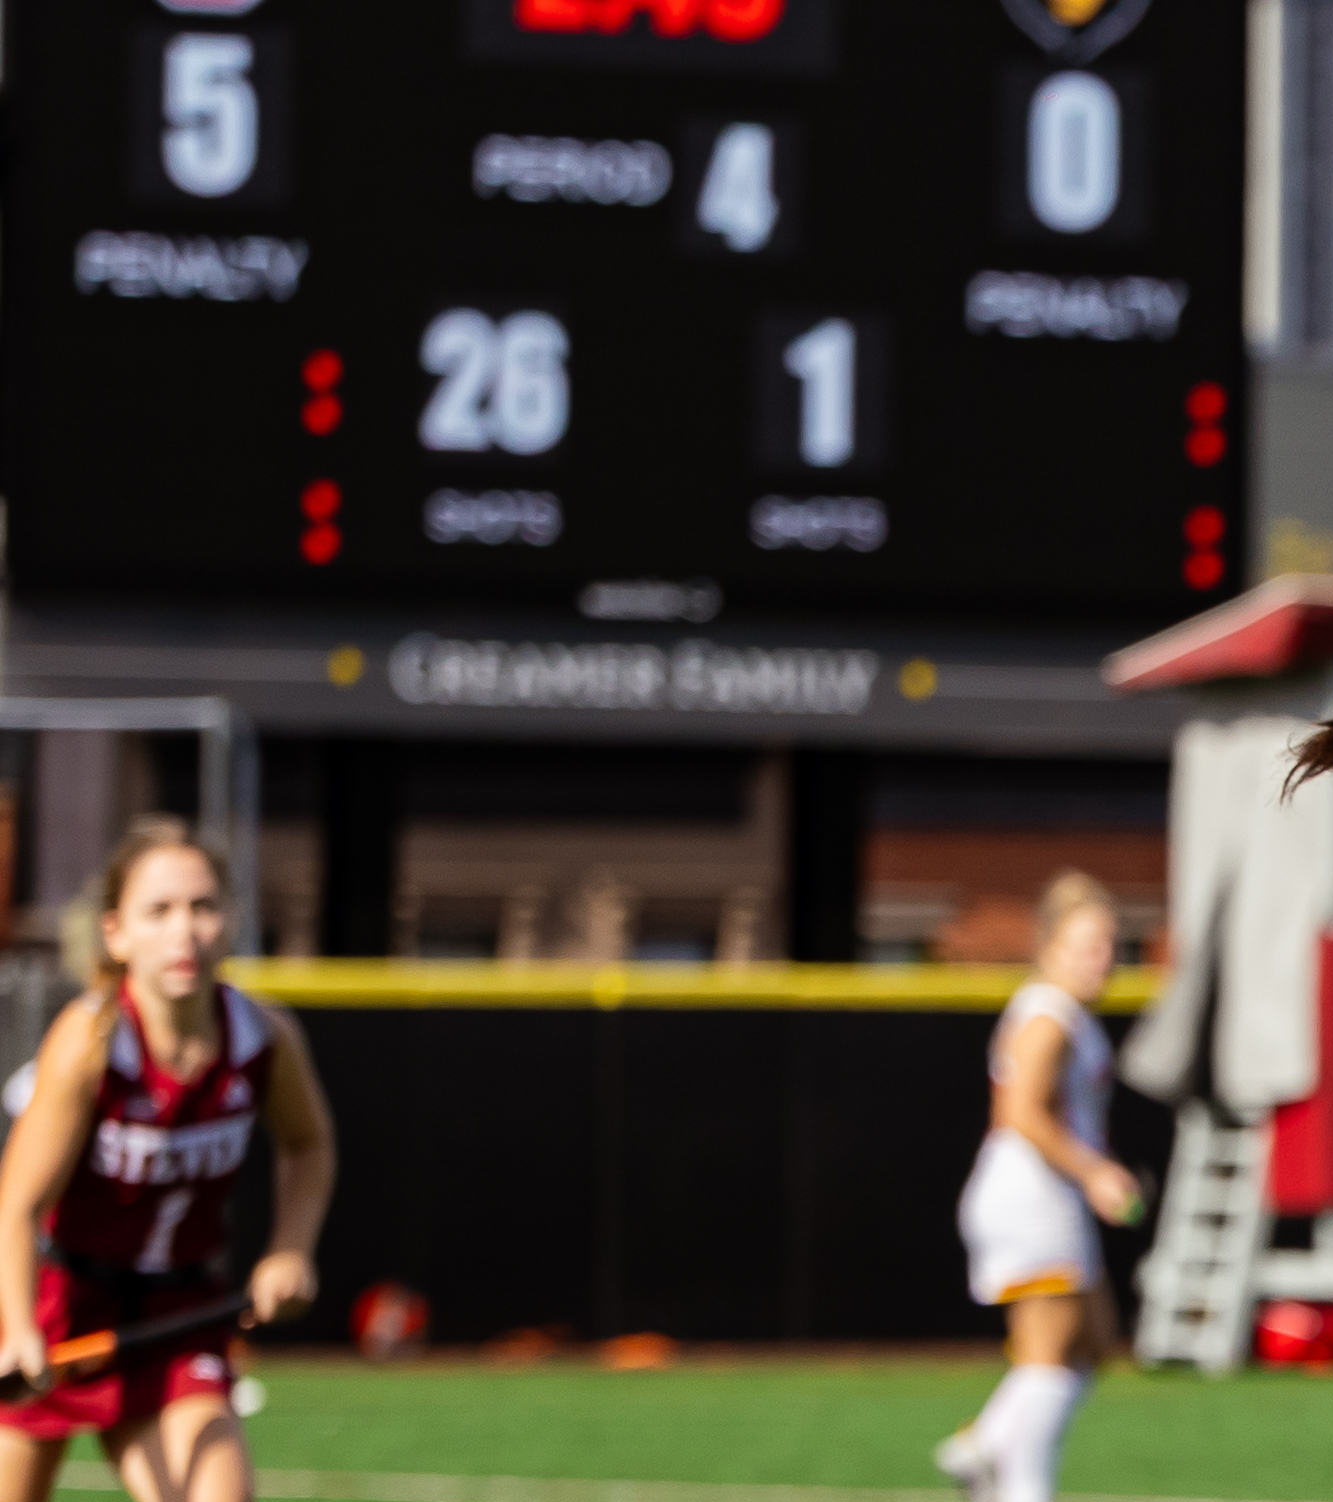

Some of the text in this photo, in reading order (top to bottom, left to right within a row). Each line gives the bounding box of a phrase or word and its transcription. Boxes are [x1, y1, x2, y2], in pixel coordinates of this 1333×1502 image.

[162, 32, 258, 197] 5
[473, 122, 780, 252] PERIOD 4
[1027, 70, 1121, 234] 0
[75, 230, 309, 301] PENALTY
[965, 269, 1189, 341] PENALTY
[420, 308, 571, 455] 26
[784, 318, 856, 467] 1
